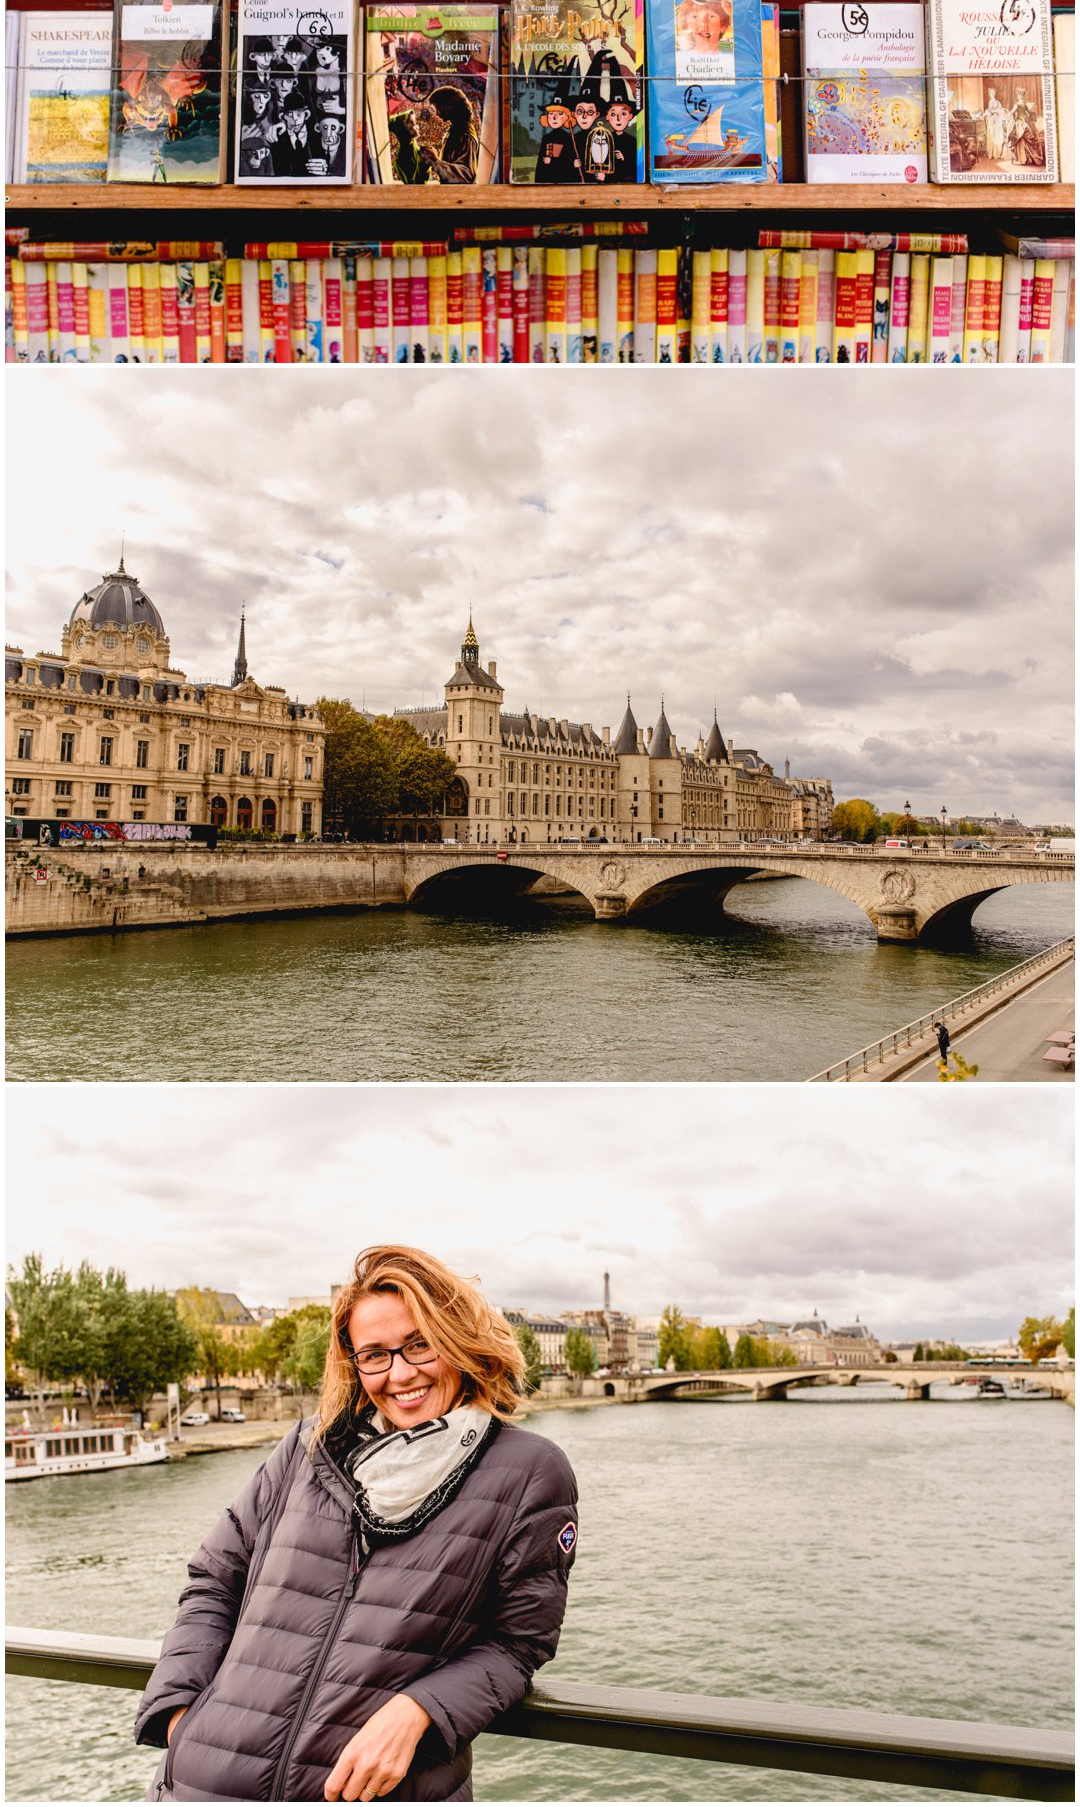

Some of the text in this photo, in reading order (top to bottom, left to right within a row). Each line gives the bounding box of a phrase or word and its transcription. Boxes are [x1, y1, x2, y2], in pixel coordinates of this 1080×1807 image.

[530, 4, 559, 13] Rowling
[153, 14, 181, 23] Tolkien
[244, 7, 293, 22] Guignol's
[380, 18, 417, 28] biblio
[514, 9, 622, 45] Harry Potter
[143, 27, 190, 35] Bilbo le hobbit
[935, 0, 944, 58] FLAMMARION
[30, 30, 113, 41] SHAKESPEAR
[817, 28, 915, 43] Georges Pompidou
[435, 40, 482, 51] Madame
[556, 42, 570, 51] DES
[877, 43, 916, 53] Anthologie
[46, 48, 79, 56] marchand
[79, 48, 88, 56] de
[948, 45, 1039, 59] LA NOUVELLE
[435, 52, 472, 65] Bovary
[842, 53, 916, 64] de la poésie française
[686, 64, 716, 73] Charlie
[937, 59, 946, 99] GARNIER
[1040, 16, 1049, 59] INTEGRAL
[1045, 112, 1055, 173] FLAMMARION
[939, 100, 947, 111] GF
[939, 111, 948, 154] INTEGRAL
[950, 173, 1055, 182] GARNIER FLAMMARION
